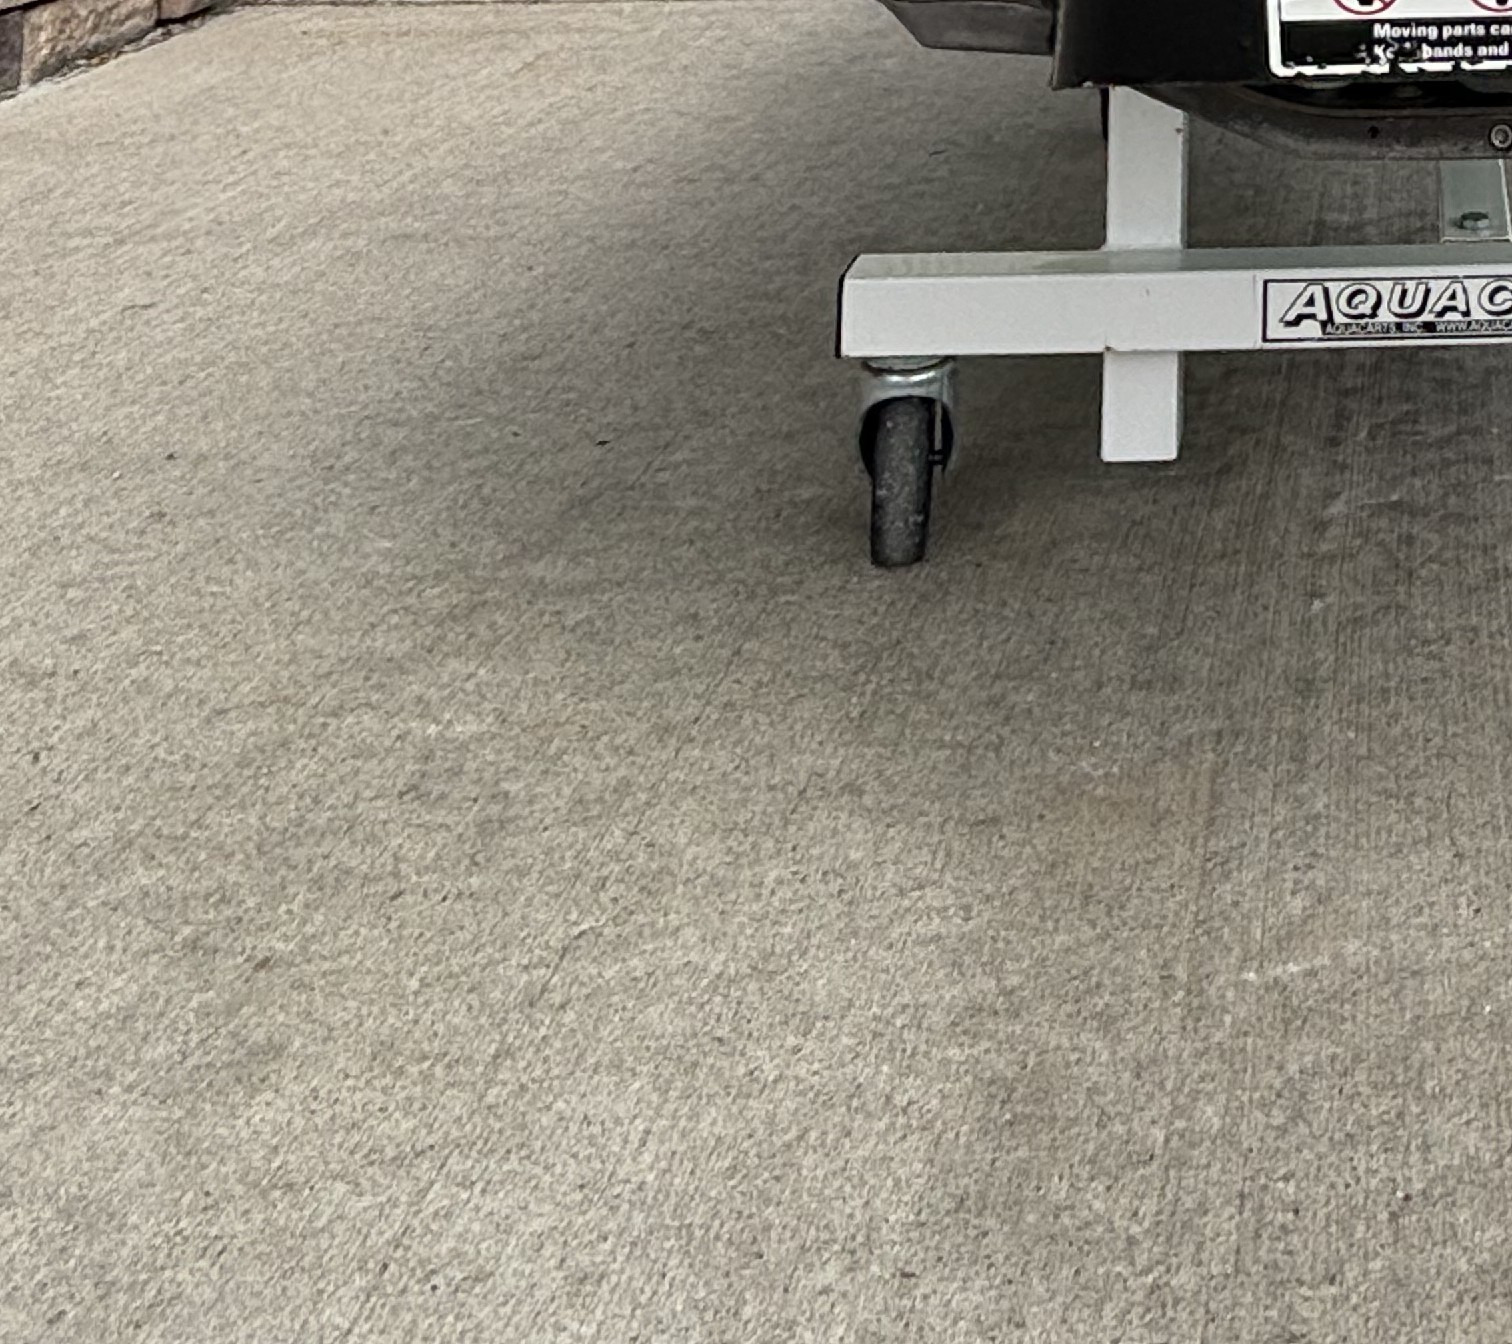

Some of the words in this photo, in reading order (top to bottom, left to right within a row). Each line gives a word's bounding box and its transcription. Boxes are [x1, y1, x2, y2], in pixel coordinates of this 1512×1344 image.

[1373, 22, 1438, 40] Moving
[1442, 22, 1486, 39] parts
[1477, 41, 1509, 57] and
